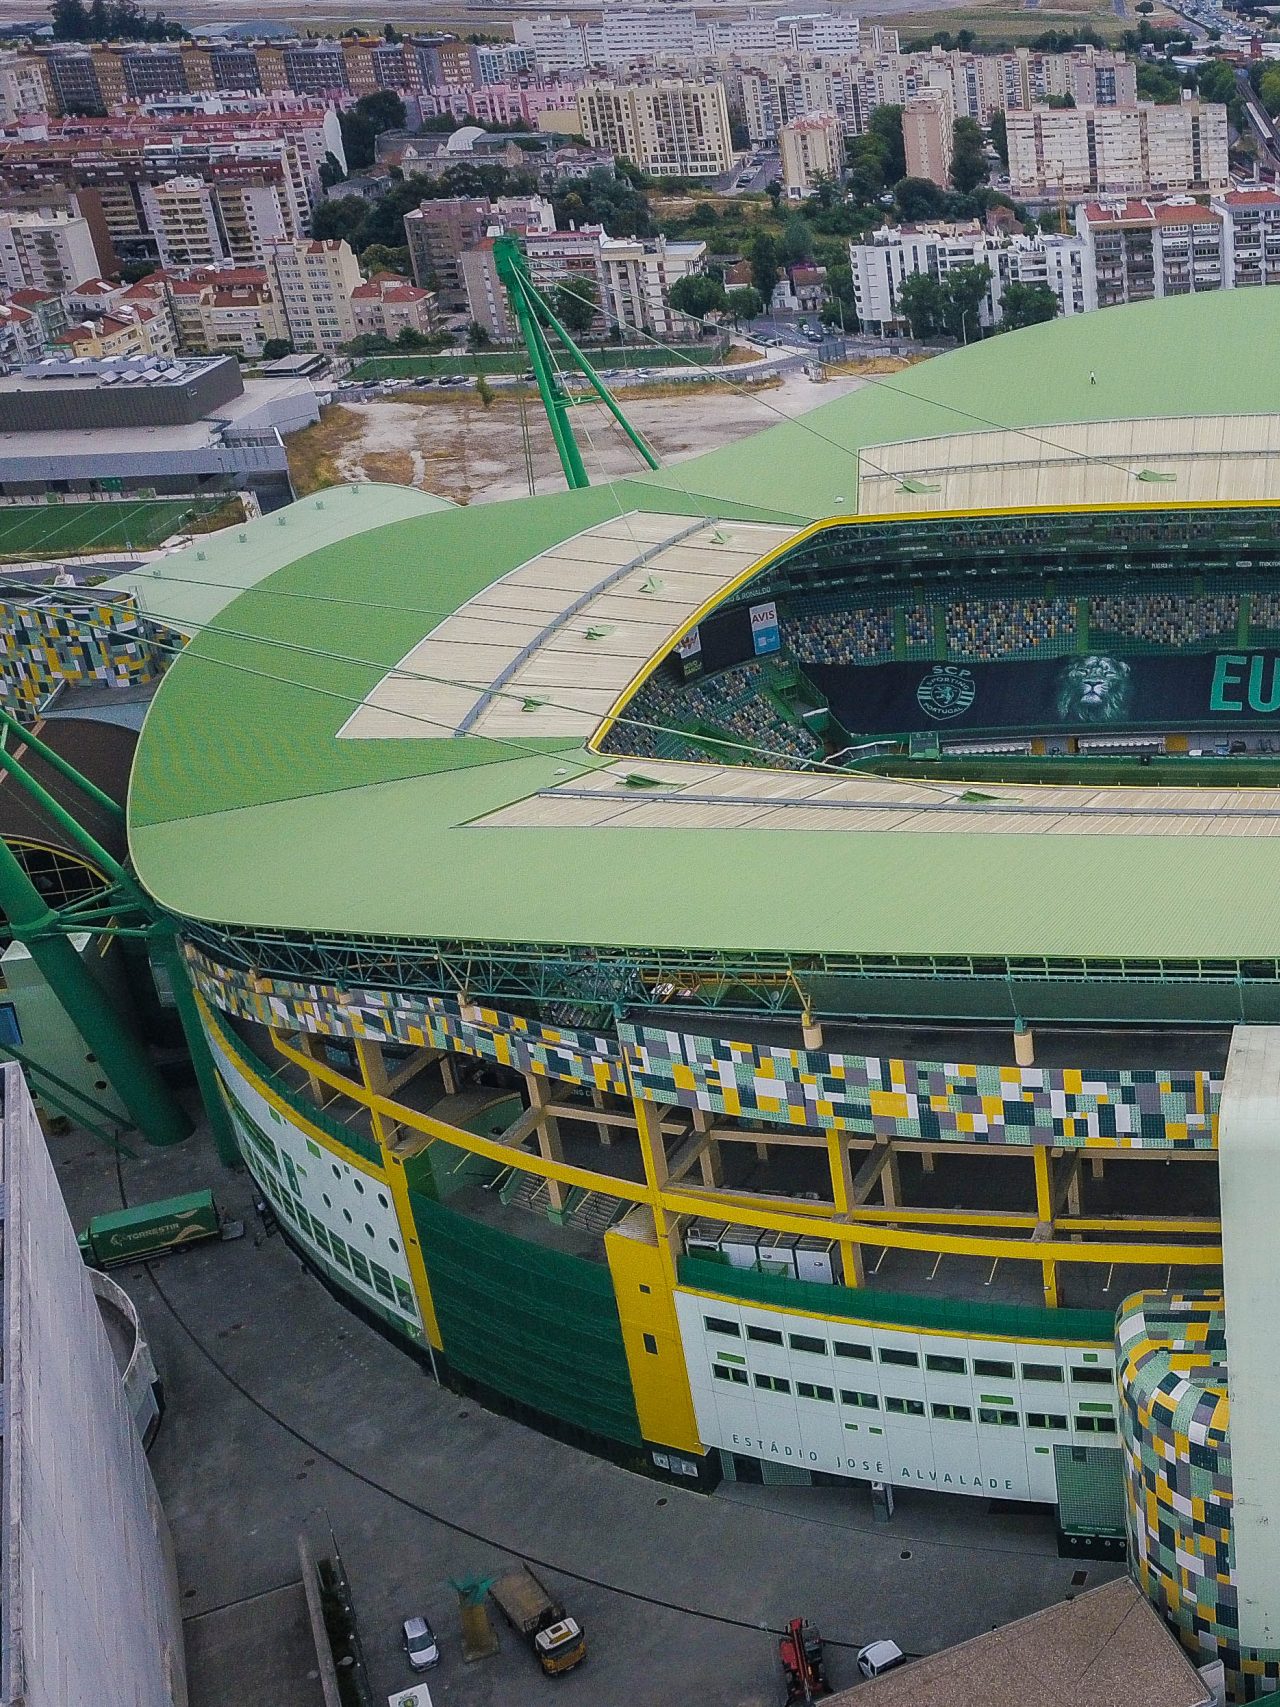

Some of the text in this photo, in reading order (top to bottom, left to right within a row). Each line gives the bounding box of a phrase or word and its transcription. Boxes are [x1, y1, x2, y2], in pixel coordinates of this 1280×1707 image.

[741, 586, 771, 599] RONALDO
[752, 610, 775, 624] AVIS
[932, 665, 972, 677] SCP
[926, 676, 970, 690] SPORTING
[923, 702, 964, 714] PORTUGAL
[127, 1223, 179, 1240] TORRESTIR
[732, 1434, 1013, 1490] ESTÁDIO JOSÉ ALVALADE
